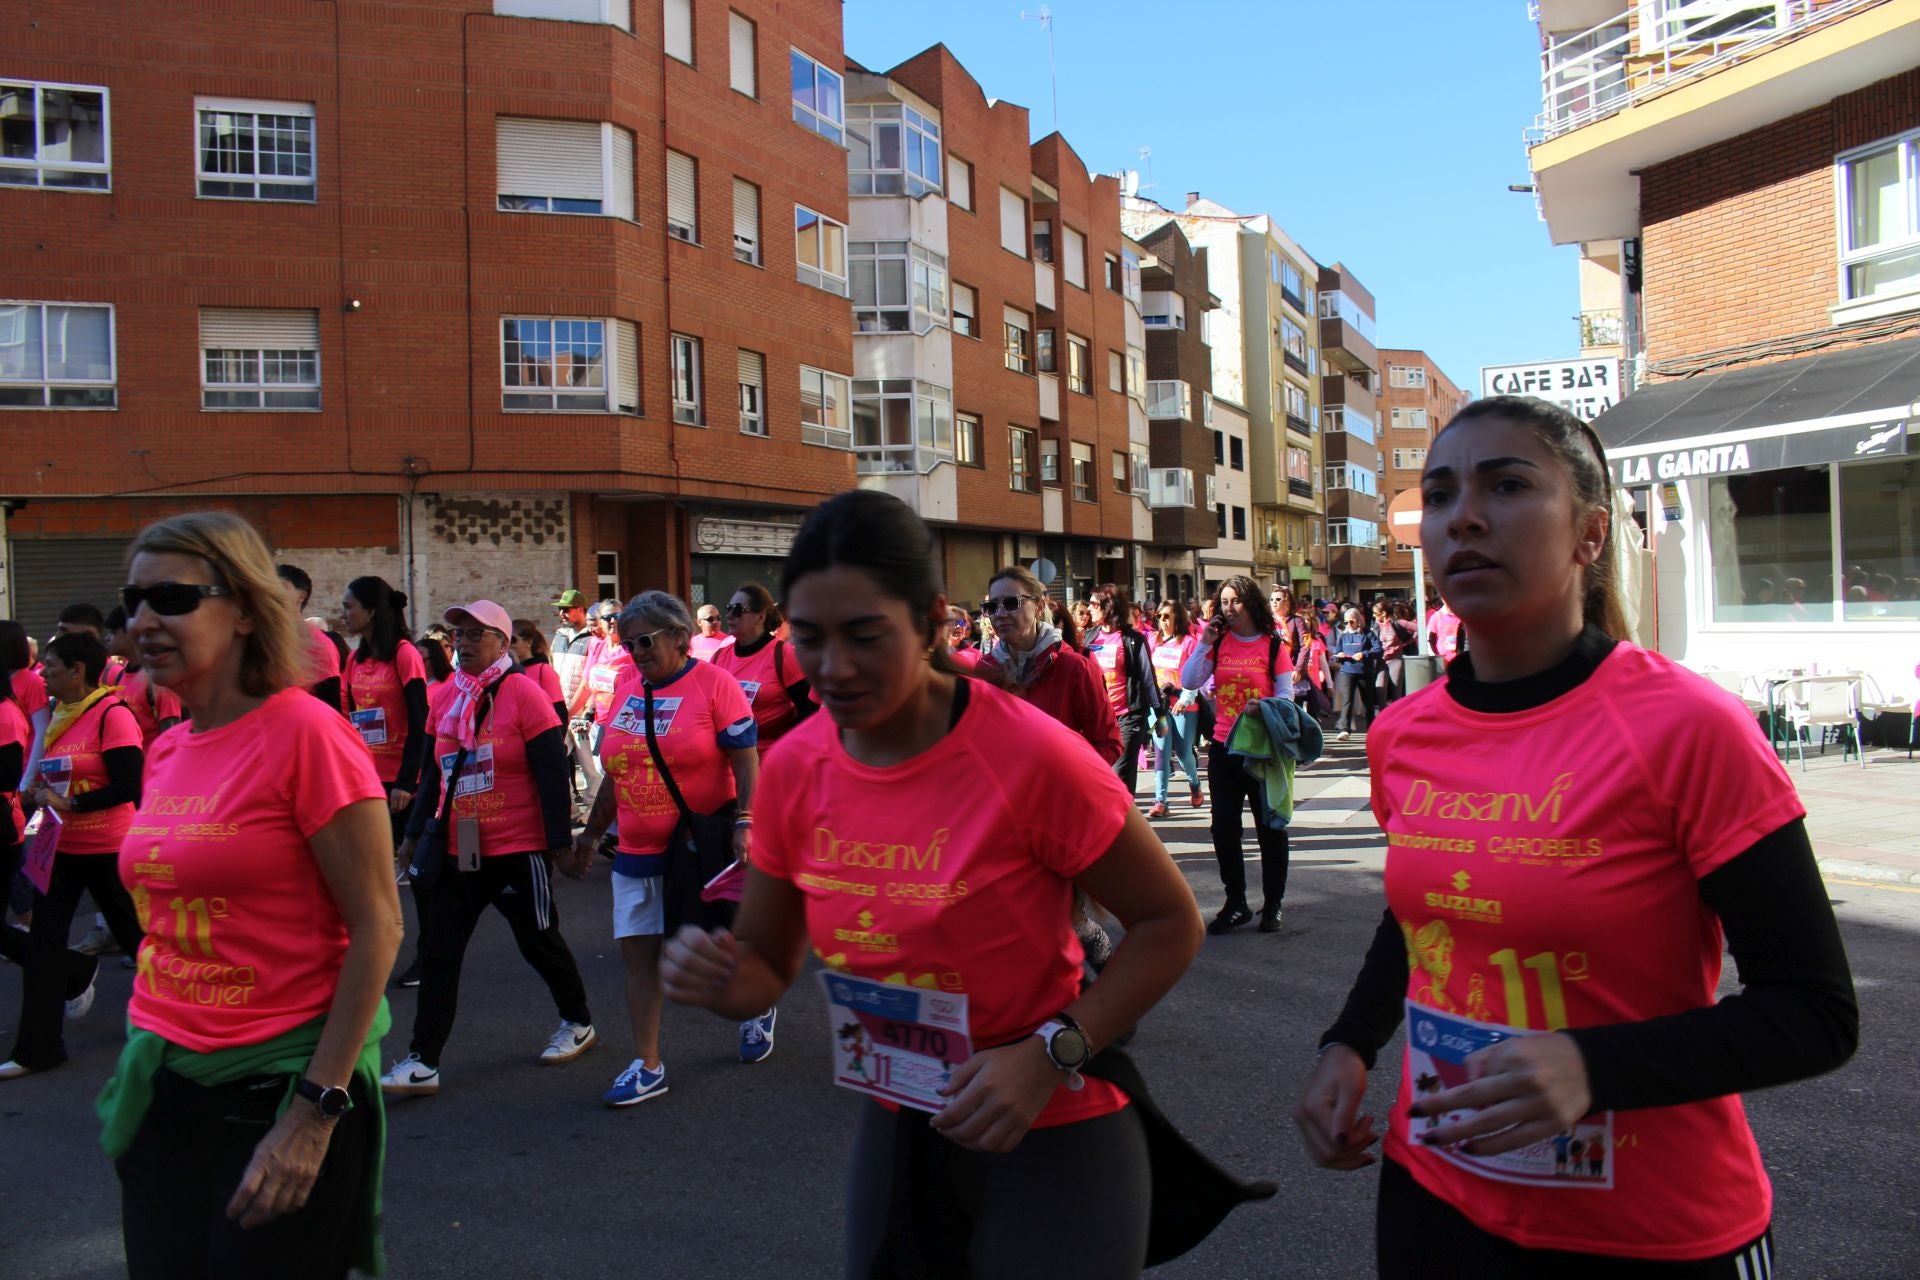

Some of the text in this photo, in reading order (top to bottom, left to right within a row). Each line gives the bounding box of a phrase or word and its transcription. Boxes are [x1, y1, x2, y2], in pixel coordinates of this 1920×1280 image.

[1492, 365, 1607, 394] CAFE BAR
[1622, 457, 1652, 483] LA
[1657, 443, 1750, 479] GARITA
[1402, 772, 1575, 823] Drasanvi
[815, 827, 950, 872] Drasanvi
[1486, 836, 1602, 857] CAROBELS
[884, 880, 968, 899] CAROBELS
[1424, 892, 1503, 915] SUZUKI
[834, 928, 898, 946] SUZUKI
[157, 953, 256, 984] Carrera
[173, 979, 257, 1008] Mujer
[883, 1022, 948, 1057] 4770
